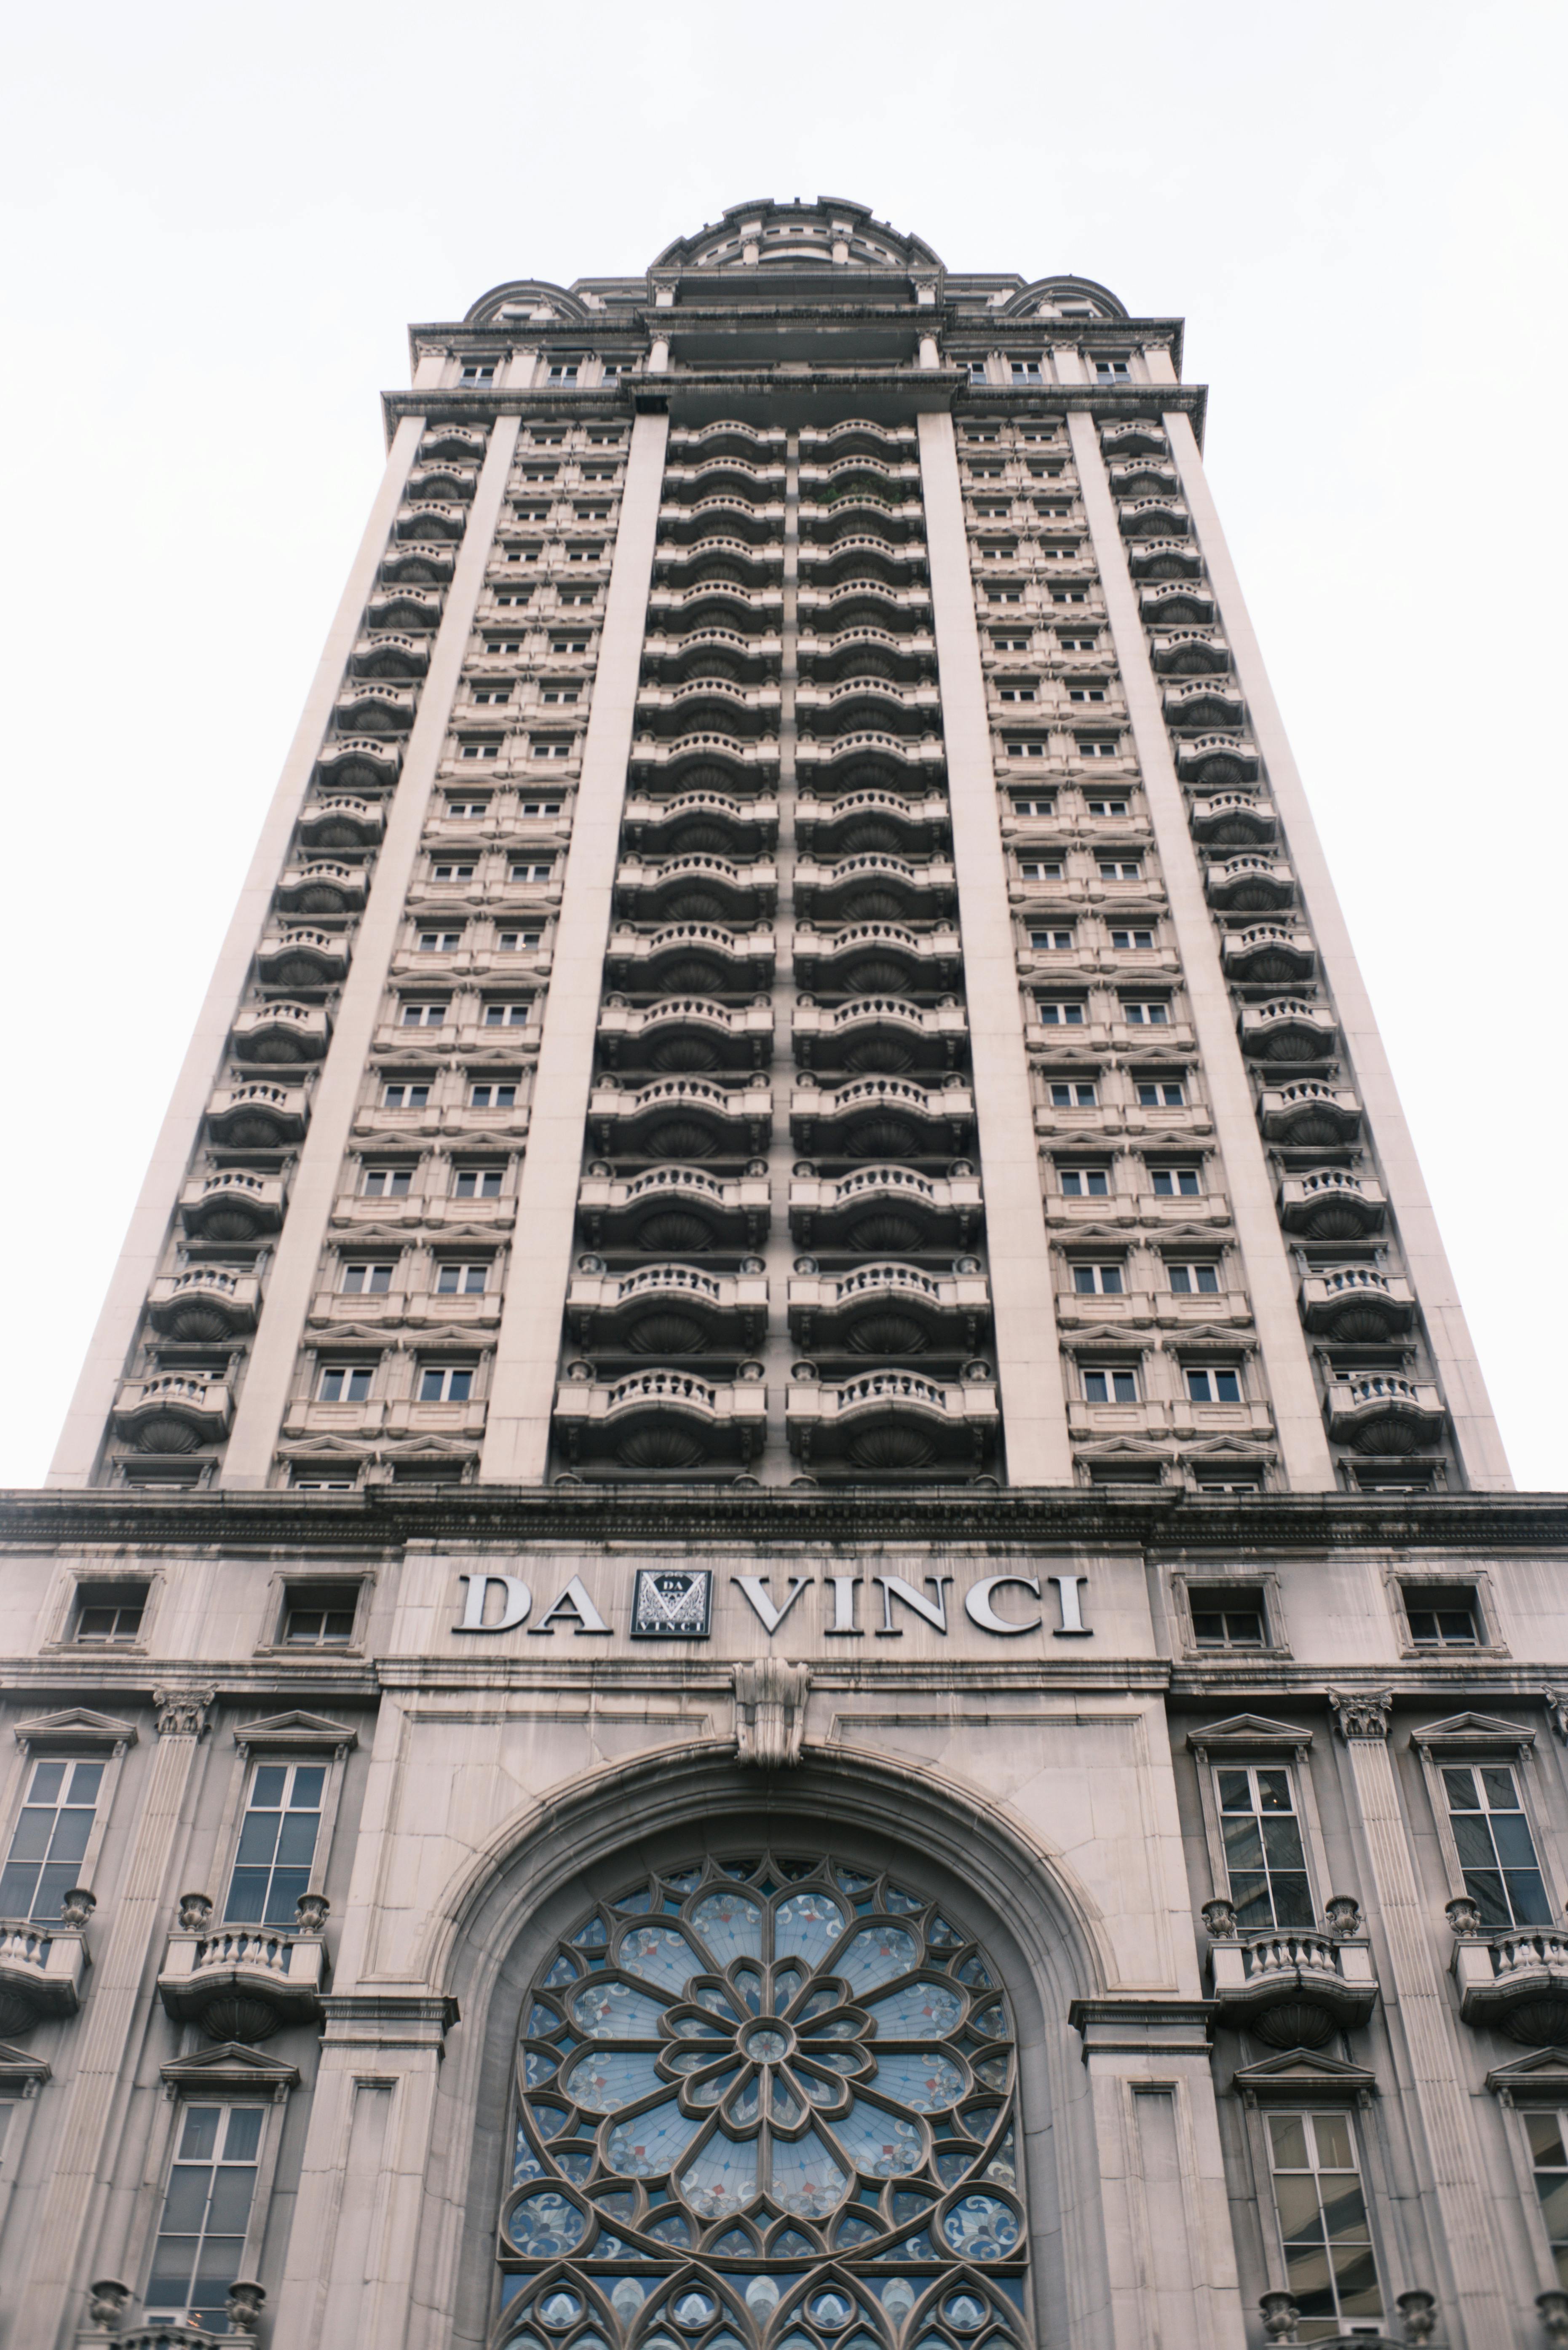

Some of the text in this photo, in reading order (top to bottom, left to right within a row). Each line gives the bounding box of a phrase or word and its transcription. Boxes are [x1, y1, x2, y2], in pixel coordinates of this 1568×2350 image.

[664, 1581, 683, 1590] DA
[451, 1574, 1094, 1636] DA VINCI
[640, 1622, 701, 1631] VINCI
